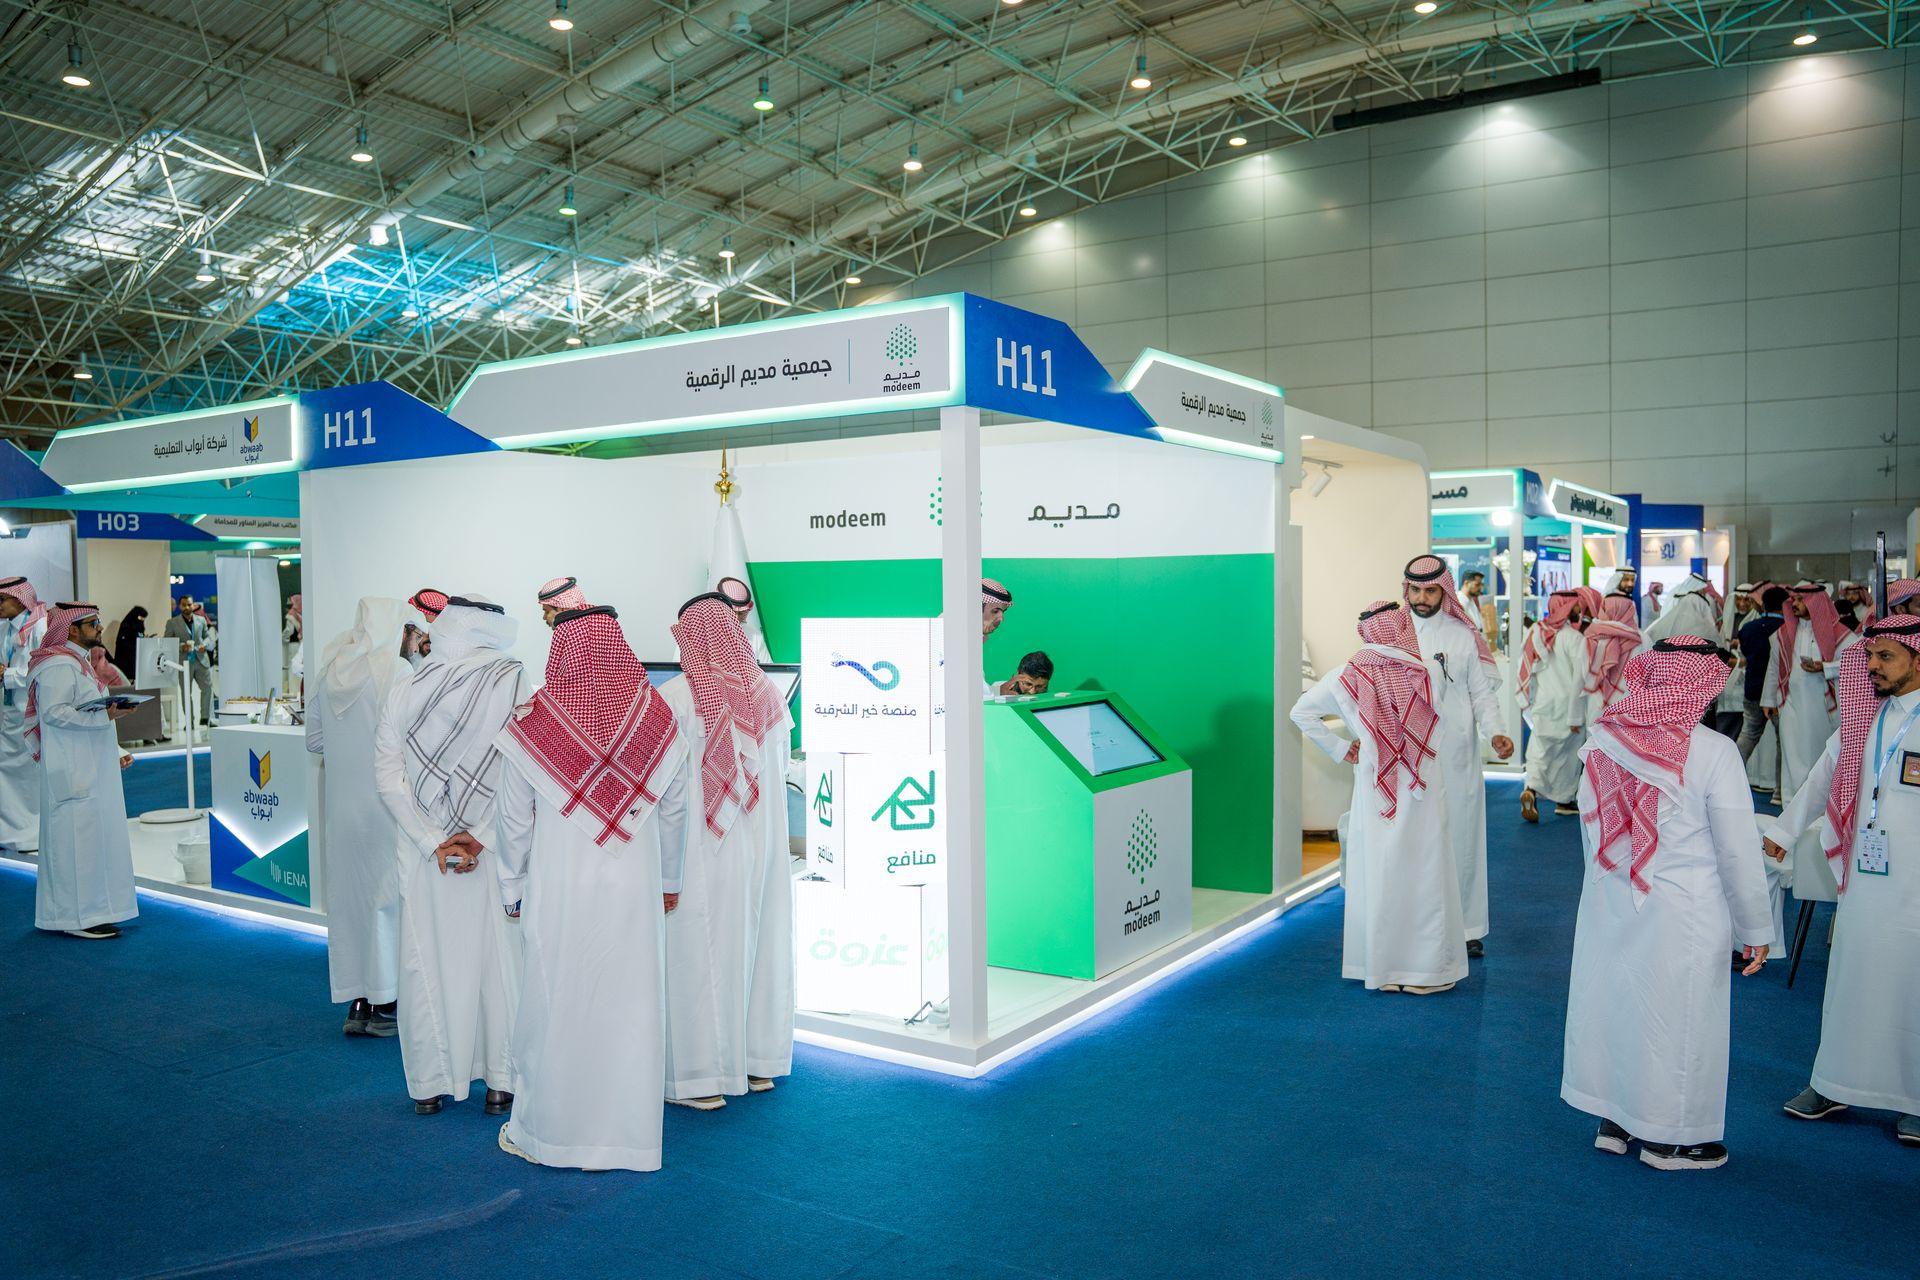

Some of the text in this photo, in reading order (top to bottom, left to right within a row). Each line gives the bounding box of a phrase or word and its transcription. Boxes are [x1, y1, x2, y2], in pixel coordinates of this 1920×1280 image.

[686, 358, 832, 392] جمعية مديم الرقمية
[997, 337, 1056, 396] H11
[883, 382, 921, 393] modeem
[1181, 391, 1246, 425] جمعية مديم الرقمية
[324, 407, 377, 448] H11
[154, 434, 228, 458] شركة أبواب التعليمية
[240, 441, 264, 454] abwaab
[97, 513, 140, 532] H03
[809, 510, 886, 529] modeem
[814, 703, 858, 718] الشرقية
[862, 703, 878, 718] خير
[881, 703, 917, 716] منصة
[243, 789, 279, 807] abwaab
[887, 850, 936, 874] منافع
[284, 871, 308, 888] IENA
[1124, 909, 1160, 936] modeem
[809, 928, 909, 967] عزوة
